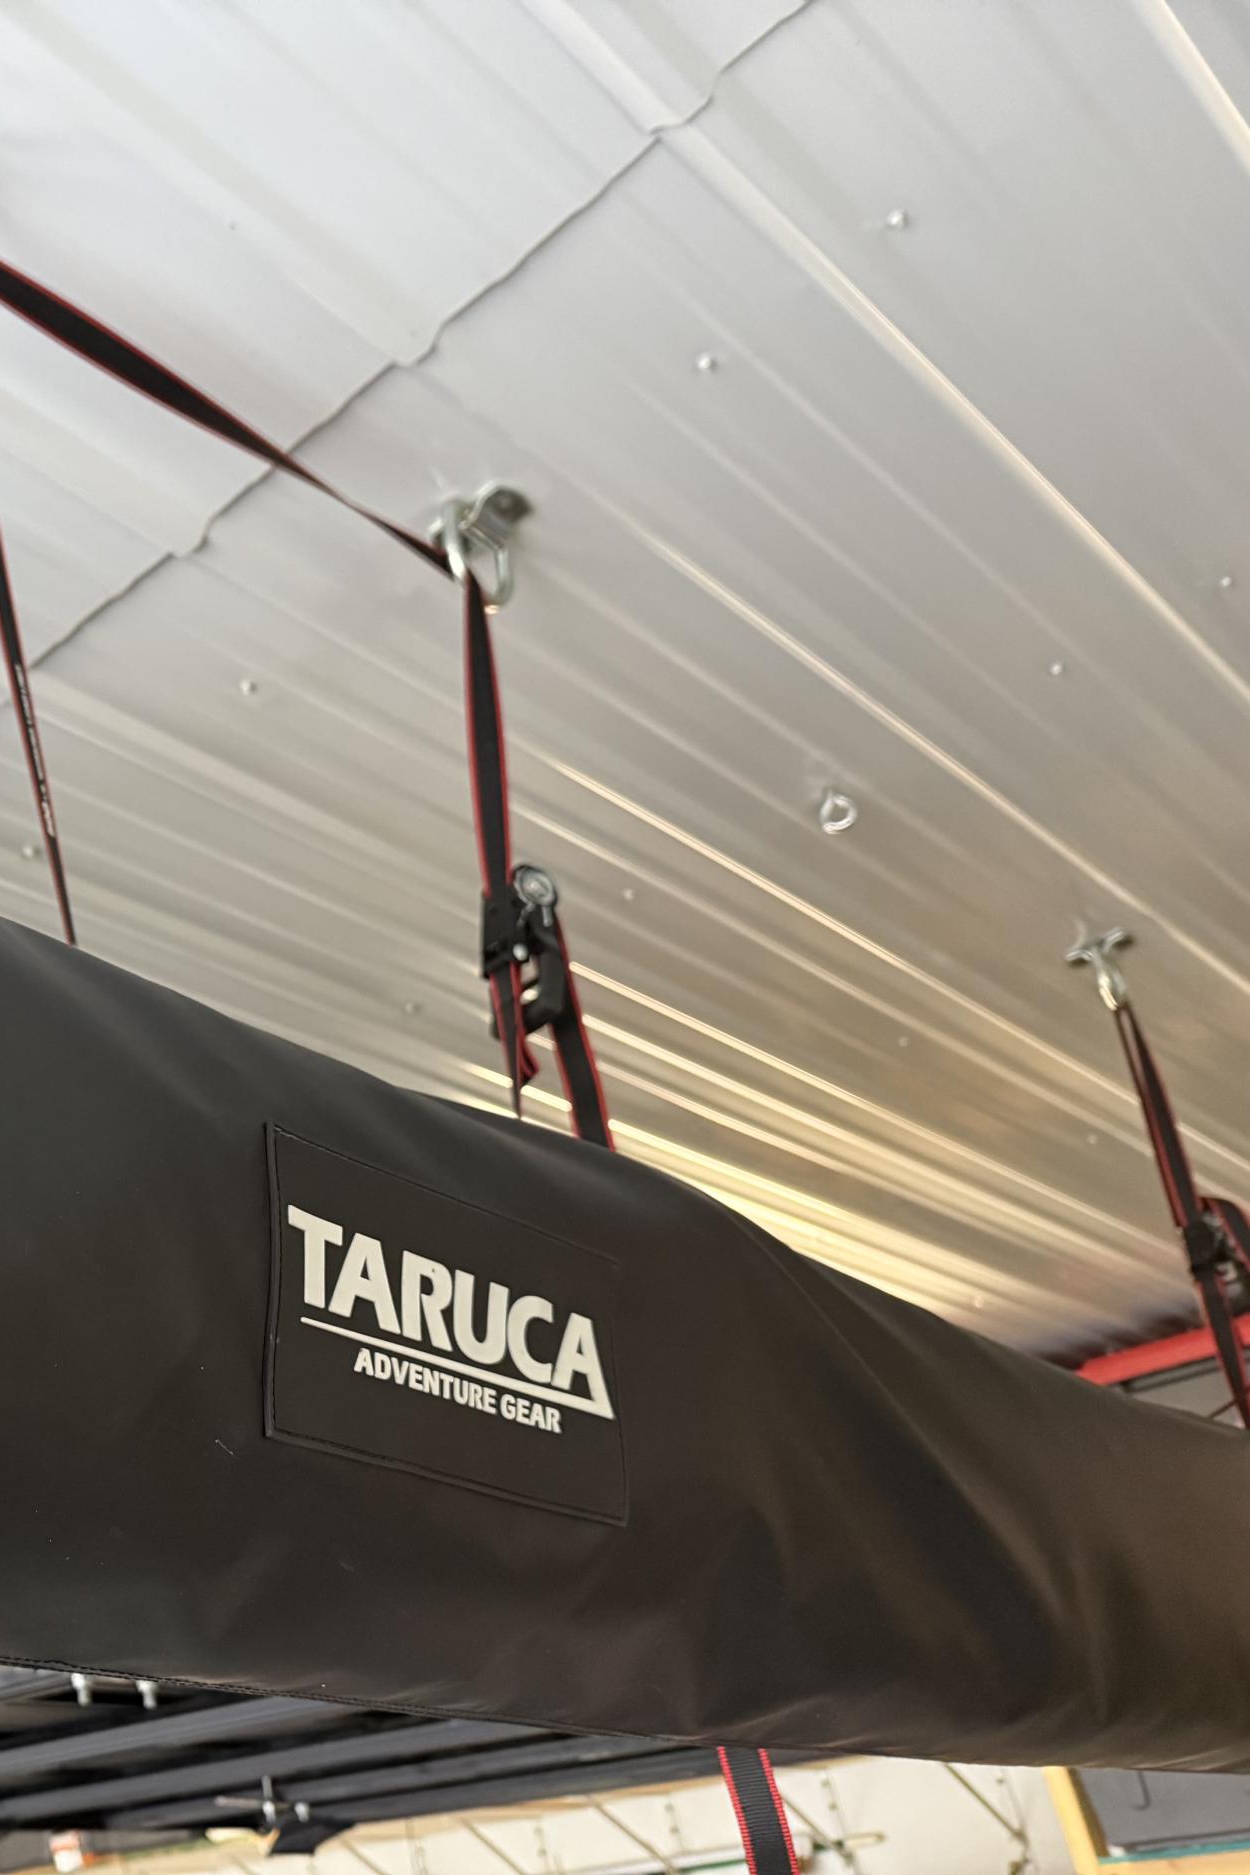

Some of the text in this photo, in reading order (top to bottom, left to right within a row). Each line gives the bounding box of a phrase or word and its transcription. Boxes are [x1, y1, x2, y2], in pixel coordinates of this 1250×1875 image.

[288, 1205, 615, 1420] TARUCA
[353, 1348, 562, 1434] ADVENTURE GEAR
